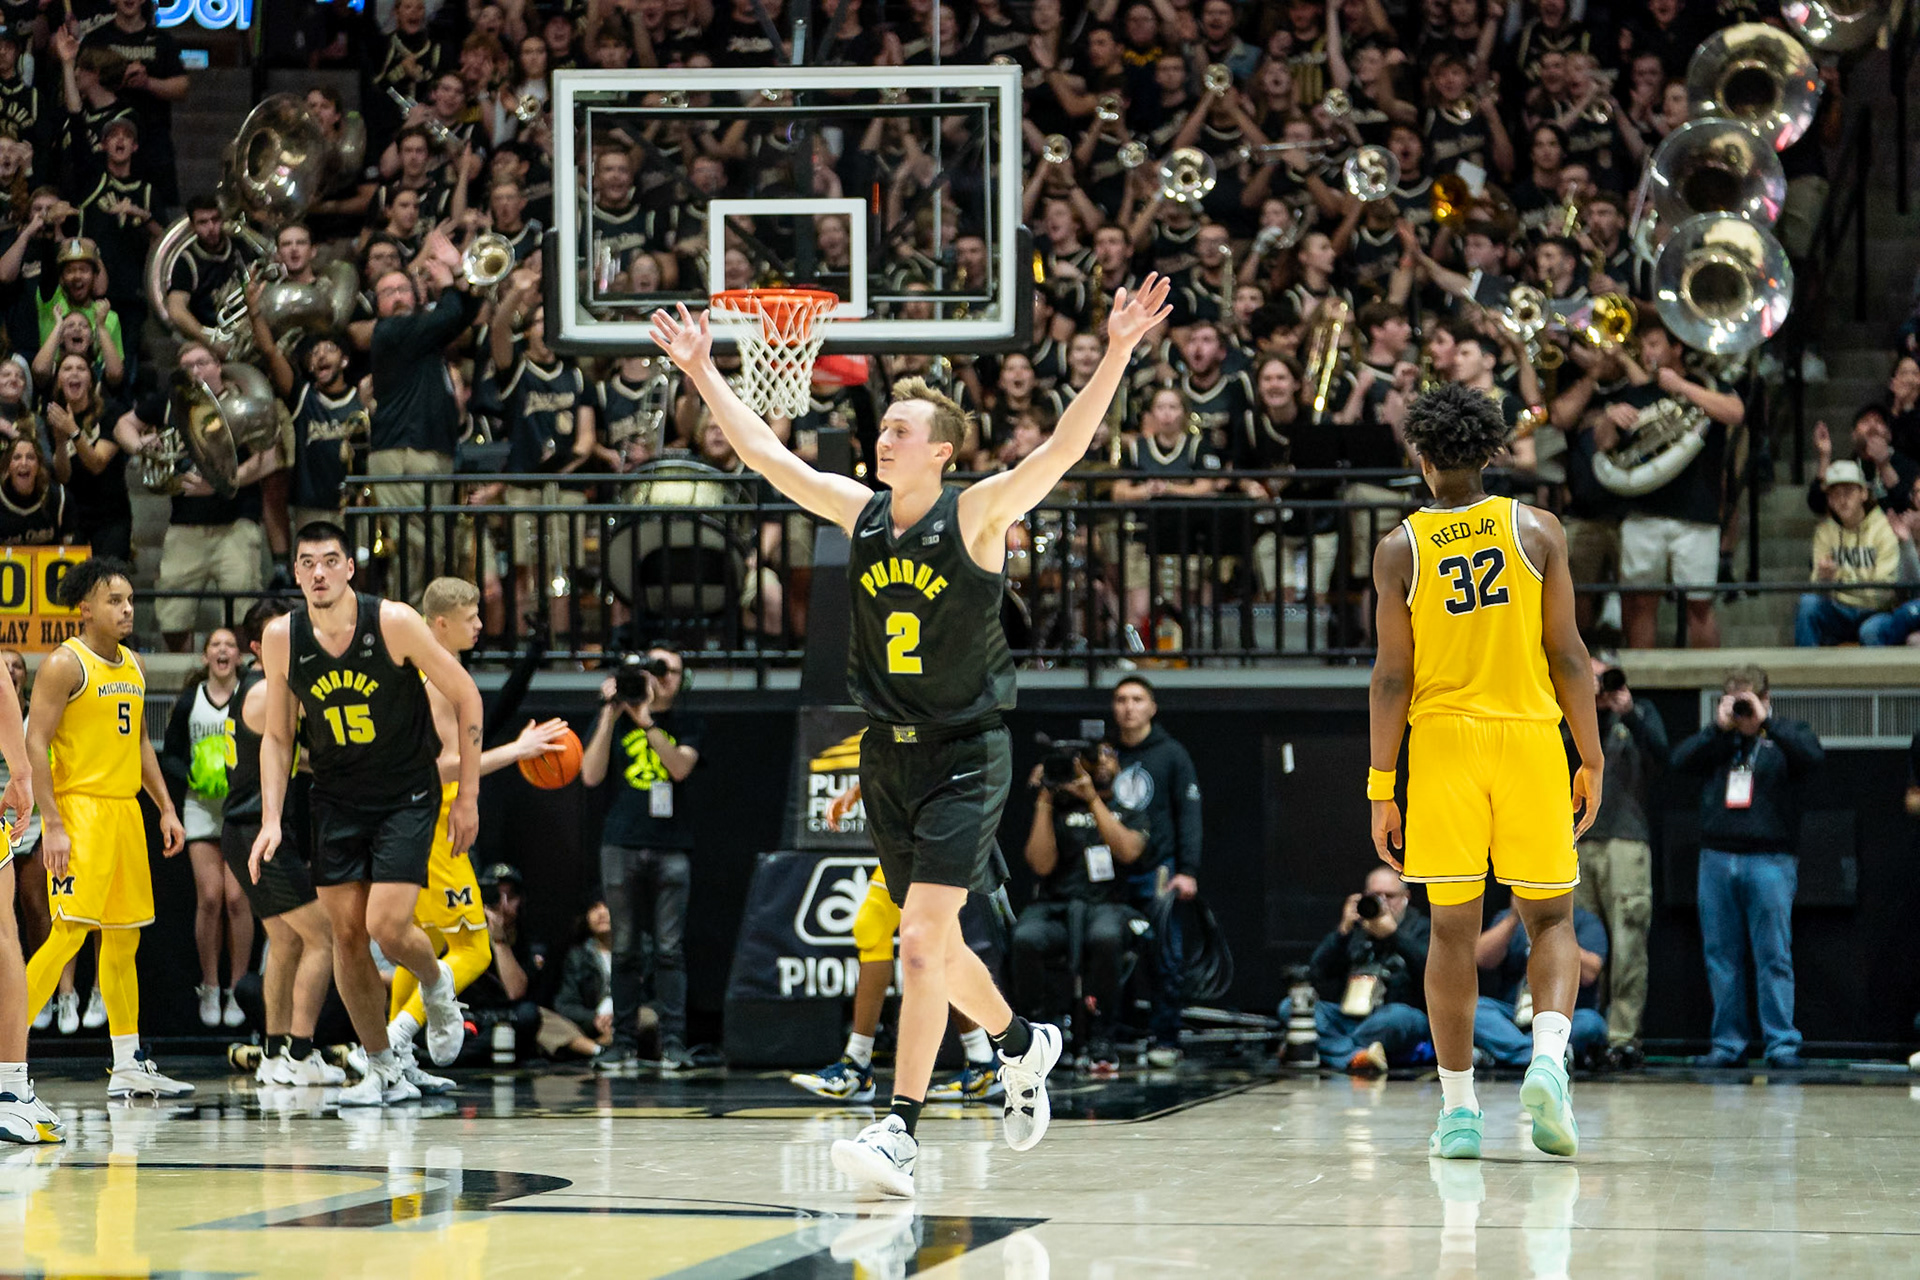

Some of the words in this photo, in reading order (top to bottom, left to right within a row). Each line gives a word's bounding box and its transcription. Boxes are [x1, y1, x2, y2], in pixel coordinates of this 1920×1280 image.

[1430, 522, 1471, 548] REED
[1475, 518, 1497, 537] JR.
[860, 557, 949, 601] PURDUE
[1437, 546, 1510, 616] 32
[886, 611, 923, 674] 2
[97, 681, 143, 698] MICHIGAN
[310, 669, 379, 701] PURDUE
[117, 702, 131, 735] 5
[323, 703, 376, 746] 15
[51, 876, 75, 896] M
[444, 886, 473, 908] M
